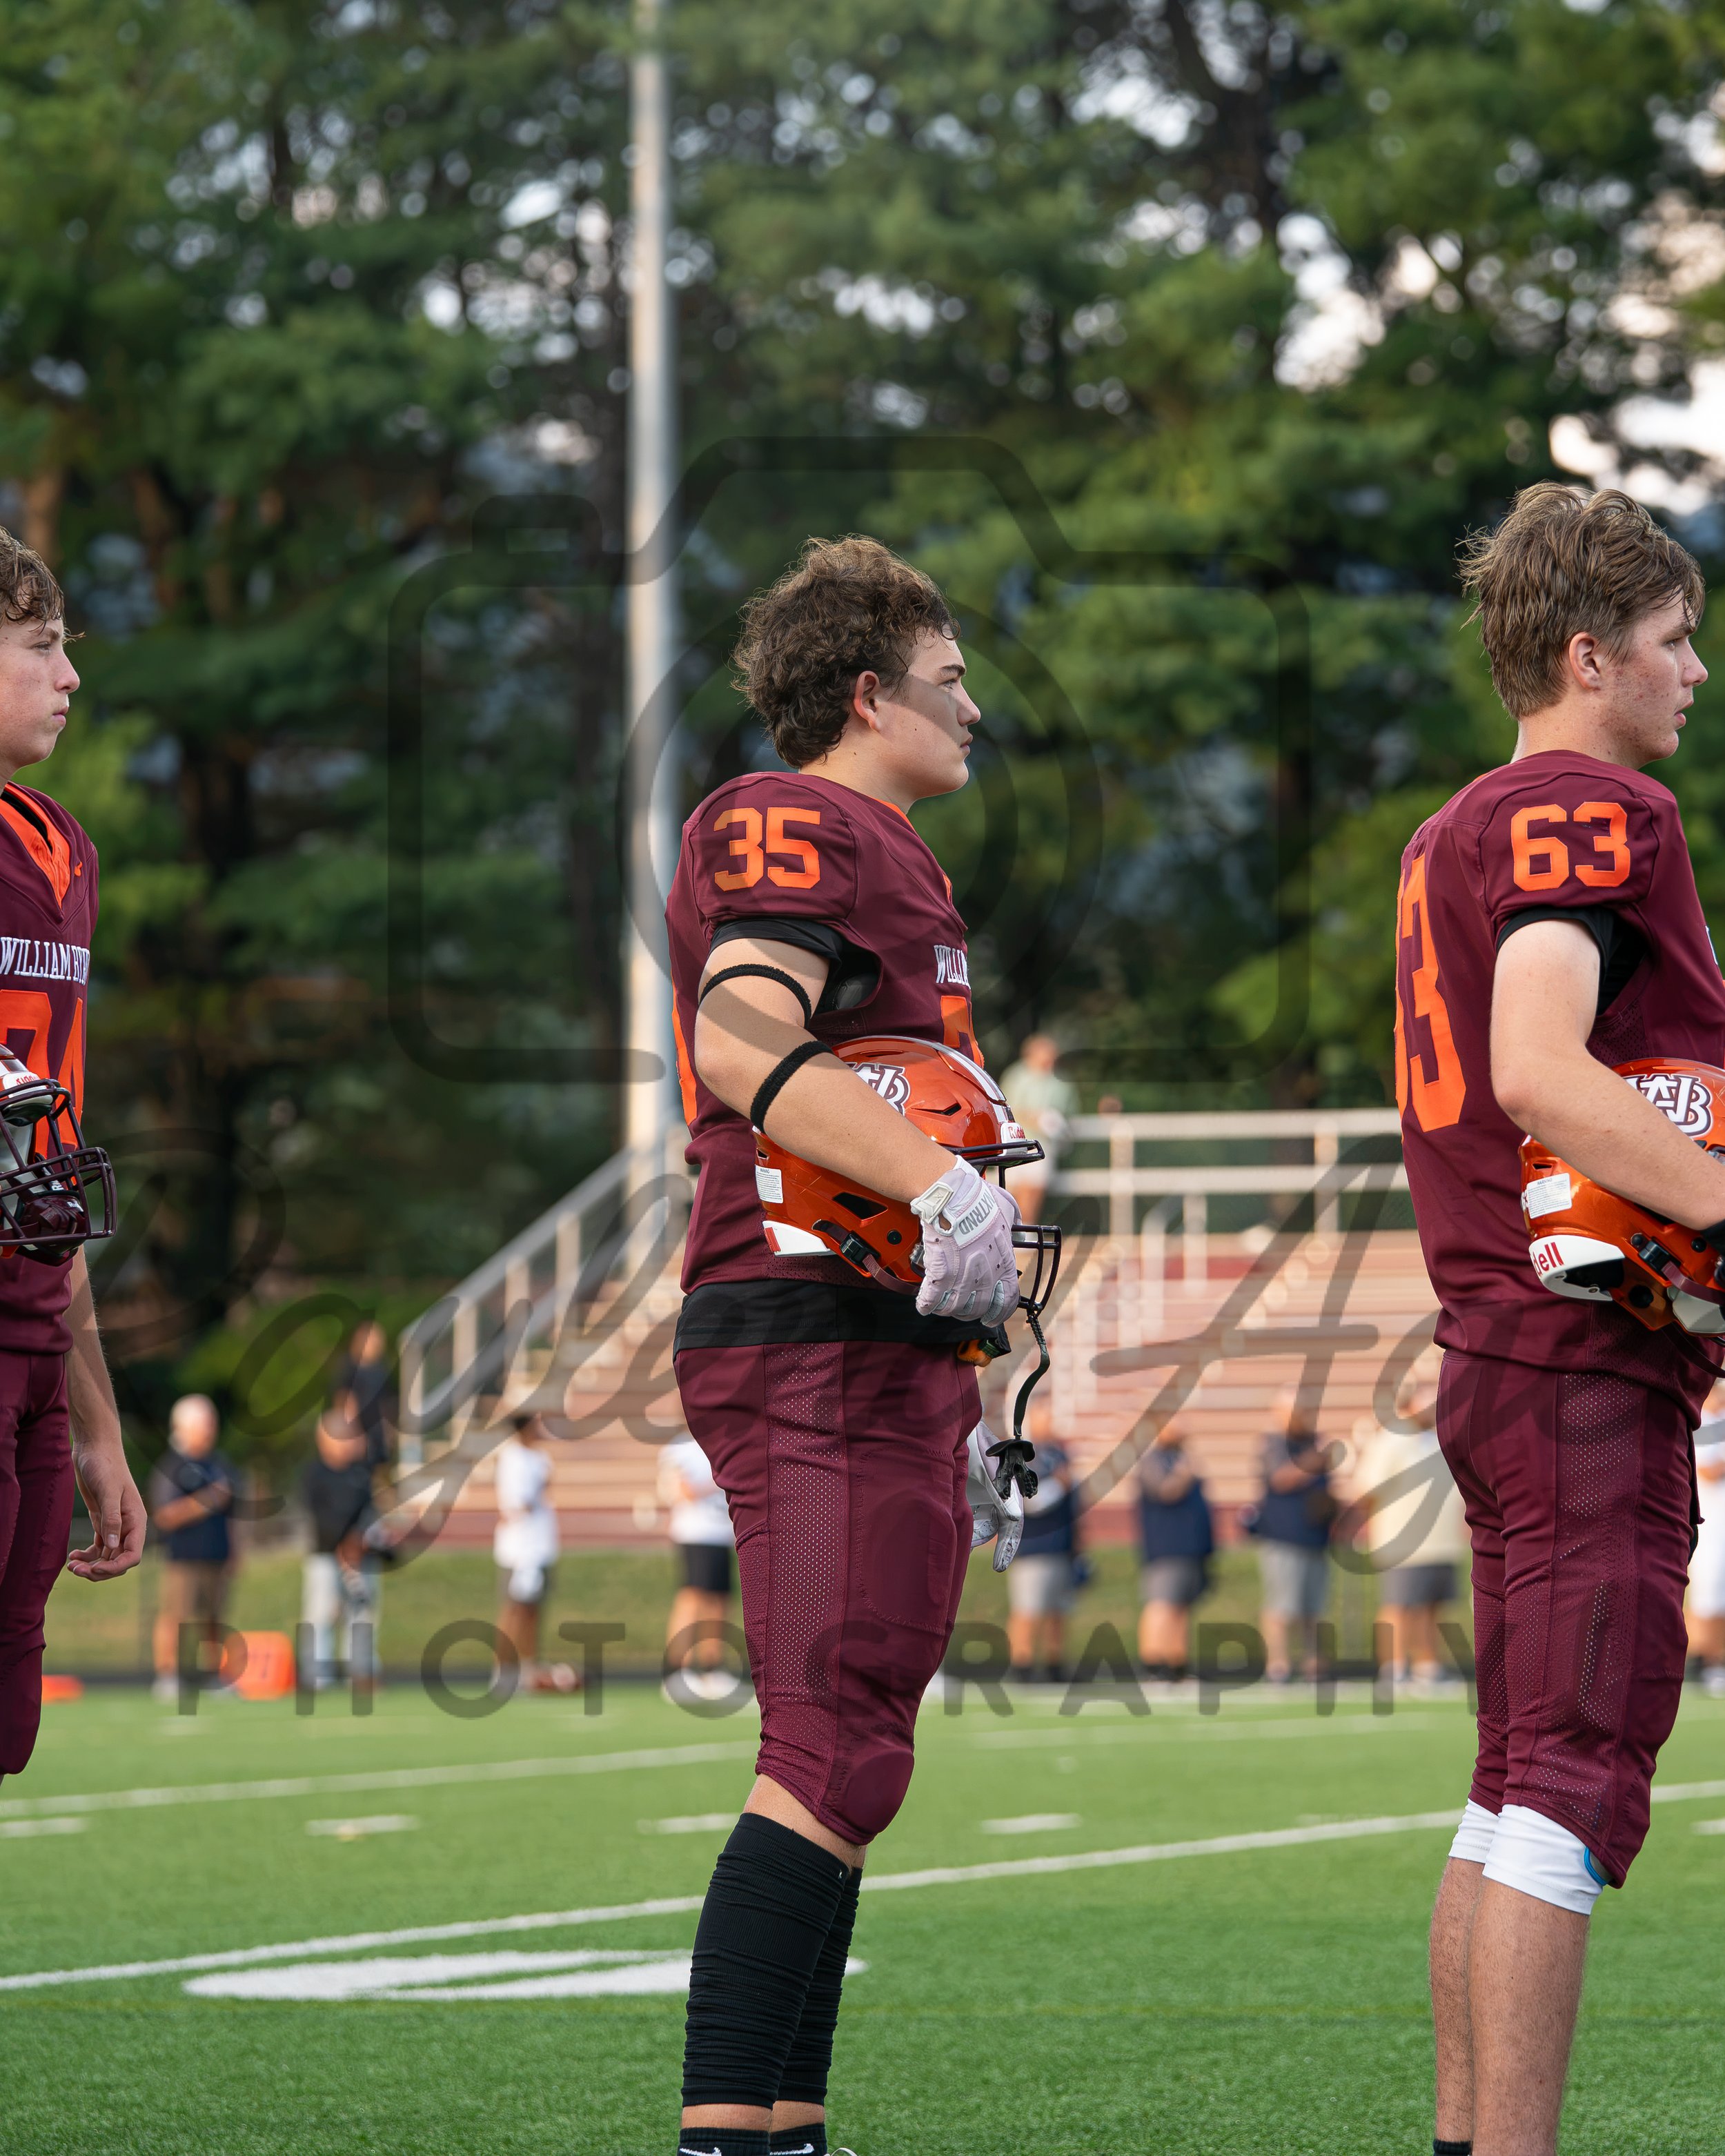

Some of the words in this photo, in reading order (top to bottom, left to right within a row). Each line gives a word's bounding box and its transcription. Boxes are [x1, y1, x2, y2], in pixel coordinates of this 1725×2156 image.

[713, 807, 821, 891] 35
[1510, 801, 1631, 892] 63
[0, 936, 72, 980] WILLIAM
[1394, 851, 1466, 1143] 3
[958, 1189, 995, 1235] NXTRND
